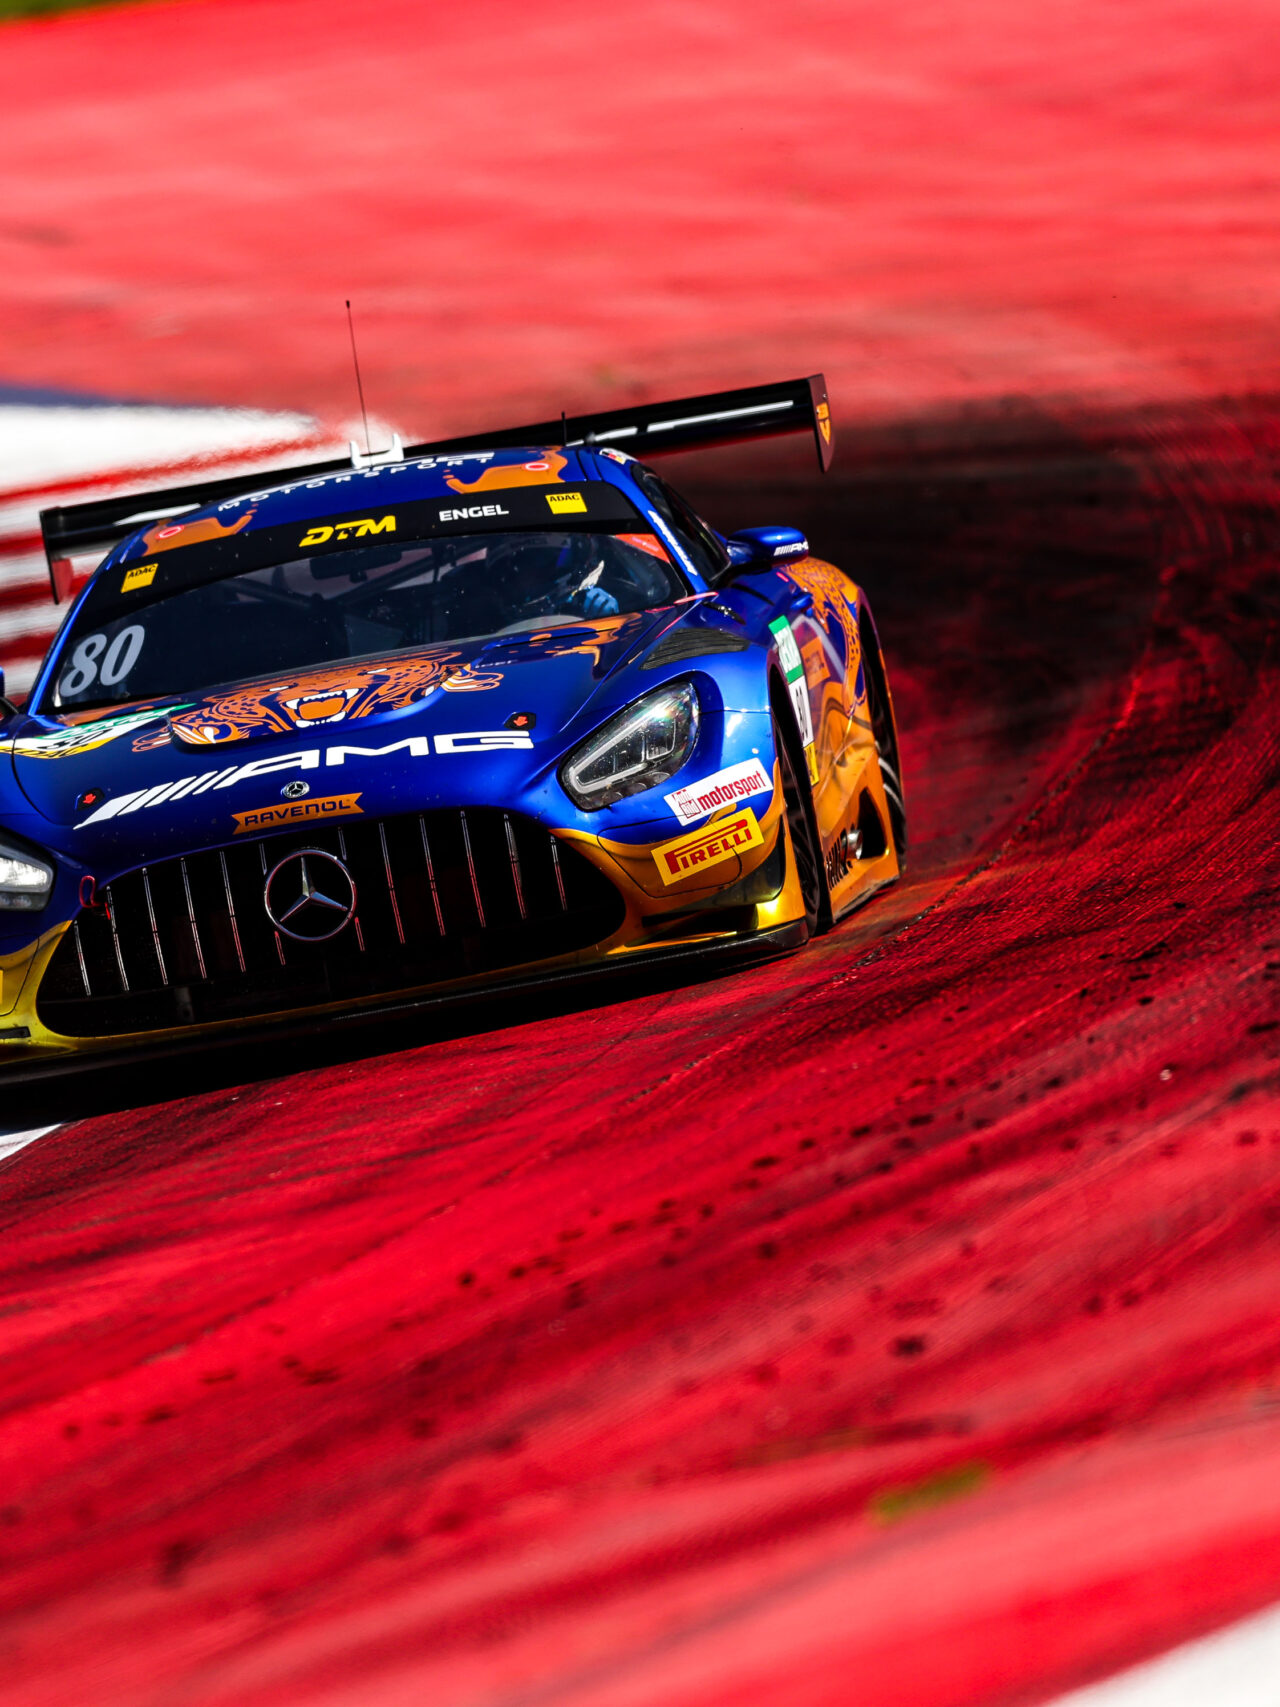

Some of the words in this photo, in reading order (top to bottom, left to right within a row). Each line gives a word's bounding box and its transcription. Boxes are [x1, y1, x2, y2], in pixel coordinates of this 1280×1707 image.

[439, 504, 509, 522] ENGEL
[549, 494, 580, 503] ADAC
[298, 515, 396, 548] DTM
[128, 565, 157, 579] ADAC
[59, 624, 146, 698] 80
[697, 770, 767, 812] motorsport
[244, 800, 352, 827] RAVENOL
[663, 818, 753, 875] PIRELLI
